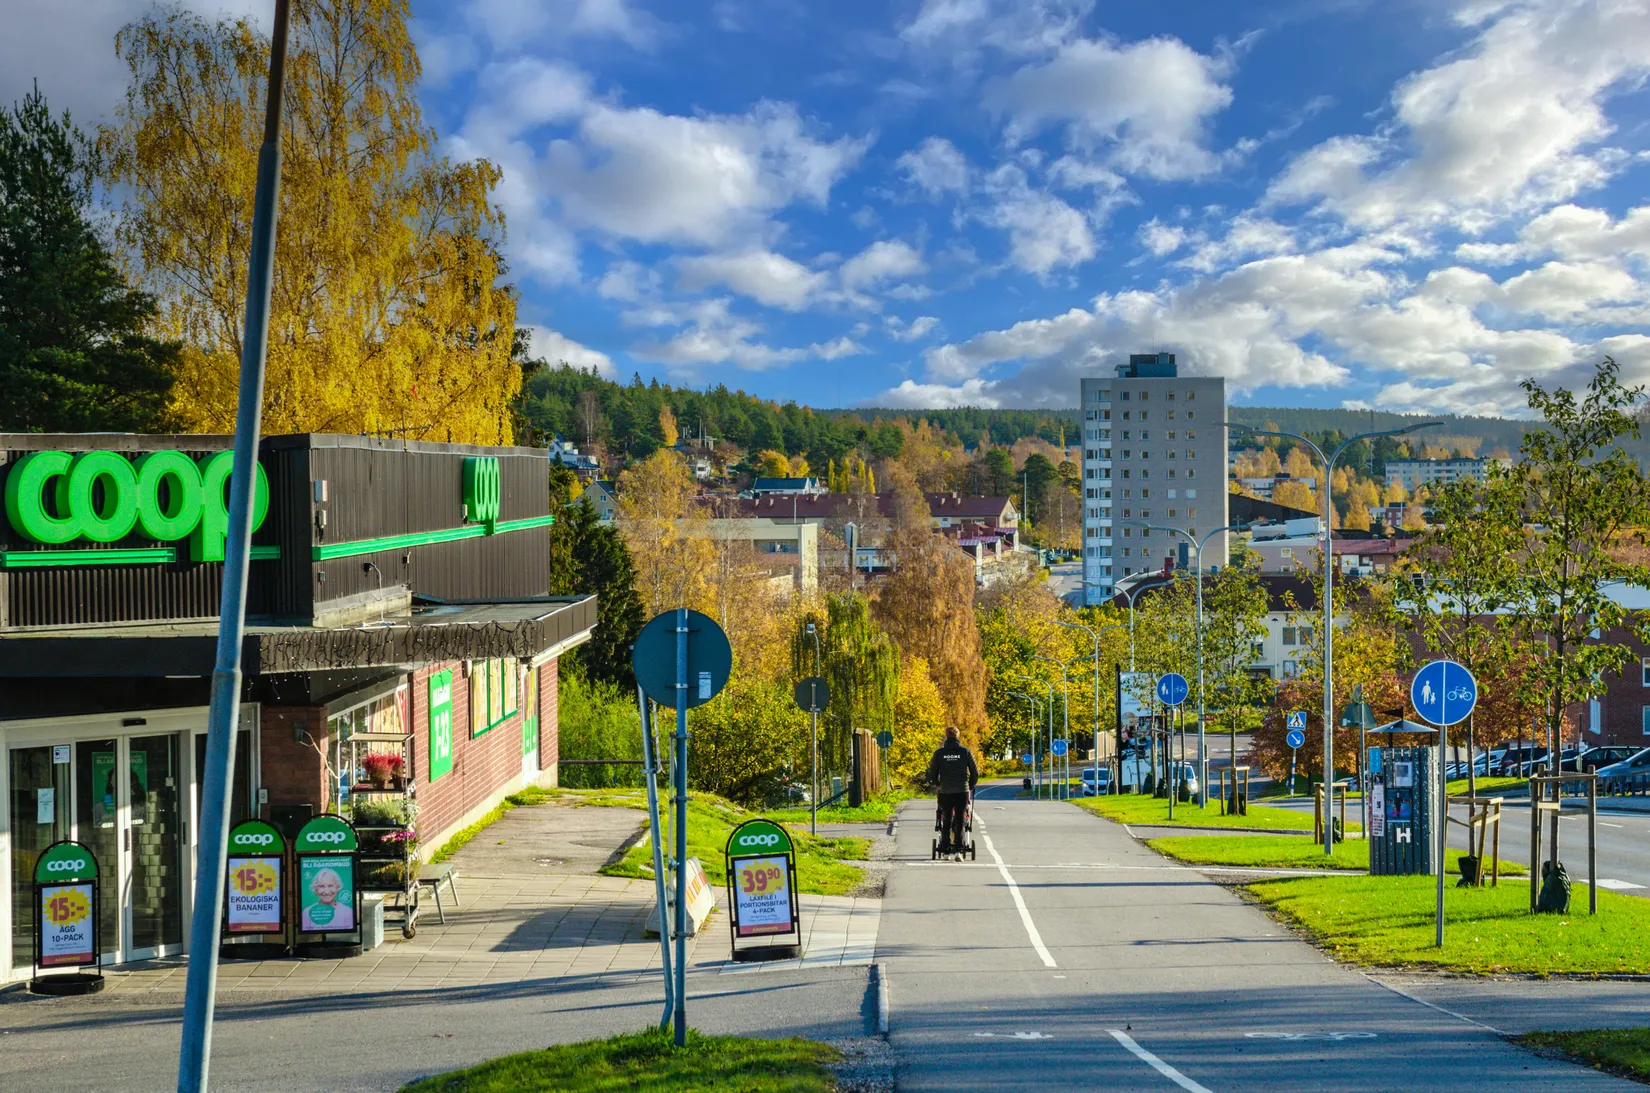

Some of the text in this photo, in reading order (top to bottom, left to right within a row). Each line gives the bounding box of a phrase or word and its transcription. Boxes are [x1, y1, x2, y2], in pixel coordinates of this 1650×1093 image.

[6, 450, 269, 561] coop
[233, 833, 274, 846] coop
[305, 831, 346, 844] coop
[739, 833, 779, 846] coop
[46, 859, 86, 872] coop
[236, 868, 273, 892] 15:-
[230, 895, 279, 903] EKOLOGISKA
[740, 899, 788, 909] PORTIONSBITAR
[49, 897, 85, 922] 15:-
[236, 903, 273, 911] BANANER
[51, 933, 84, 943] 10-PACK
